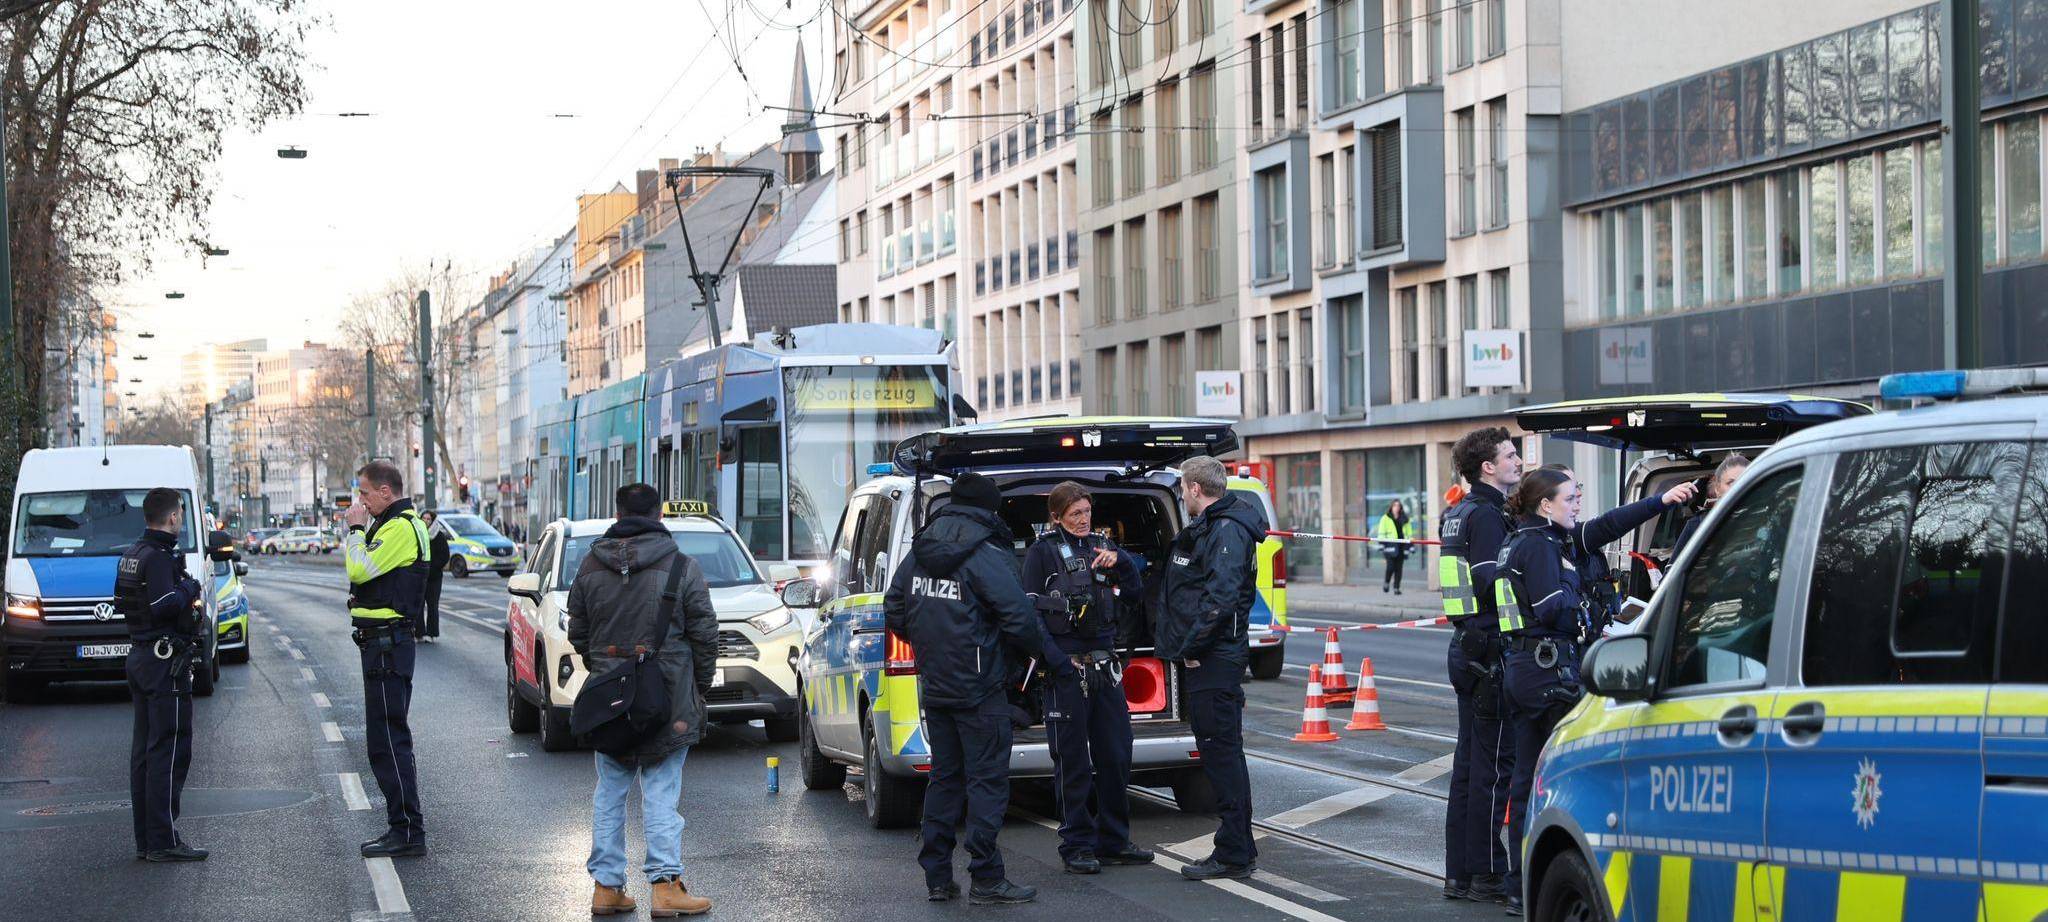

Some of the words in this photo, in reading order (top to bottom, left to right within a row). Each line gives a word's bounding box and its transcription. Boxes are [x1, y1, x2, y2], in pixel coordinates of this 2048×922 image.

[1473, 344, 1513, 361] bwb
[814, 382, 916, 404] Sonderzug
[1203, 382, 1234, 396] bwb
[672, 502, 701, 512] TAXI
[911, 576, 962, 601] POLIZEI
[1649, 765, 1733, 813] POLIZEI
